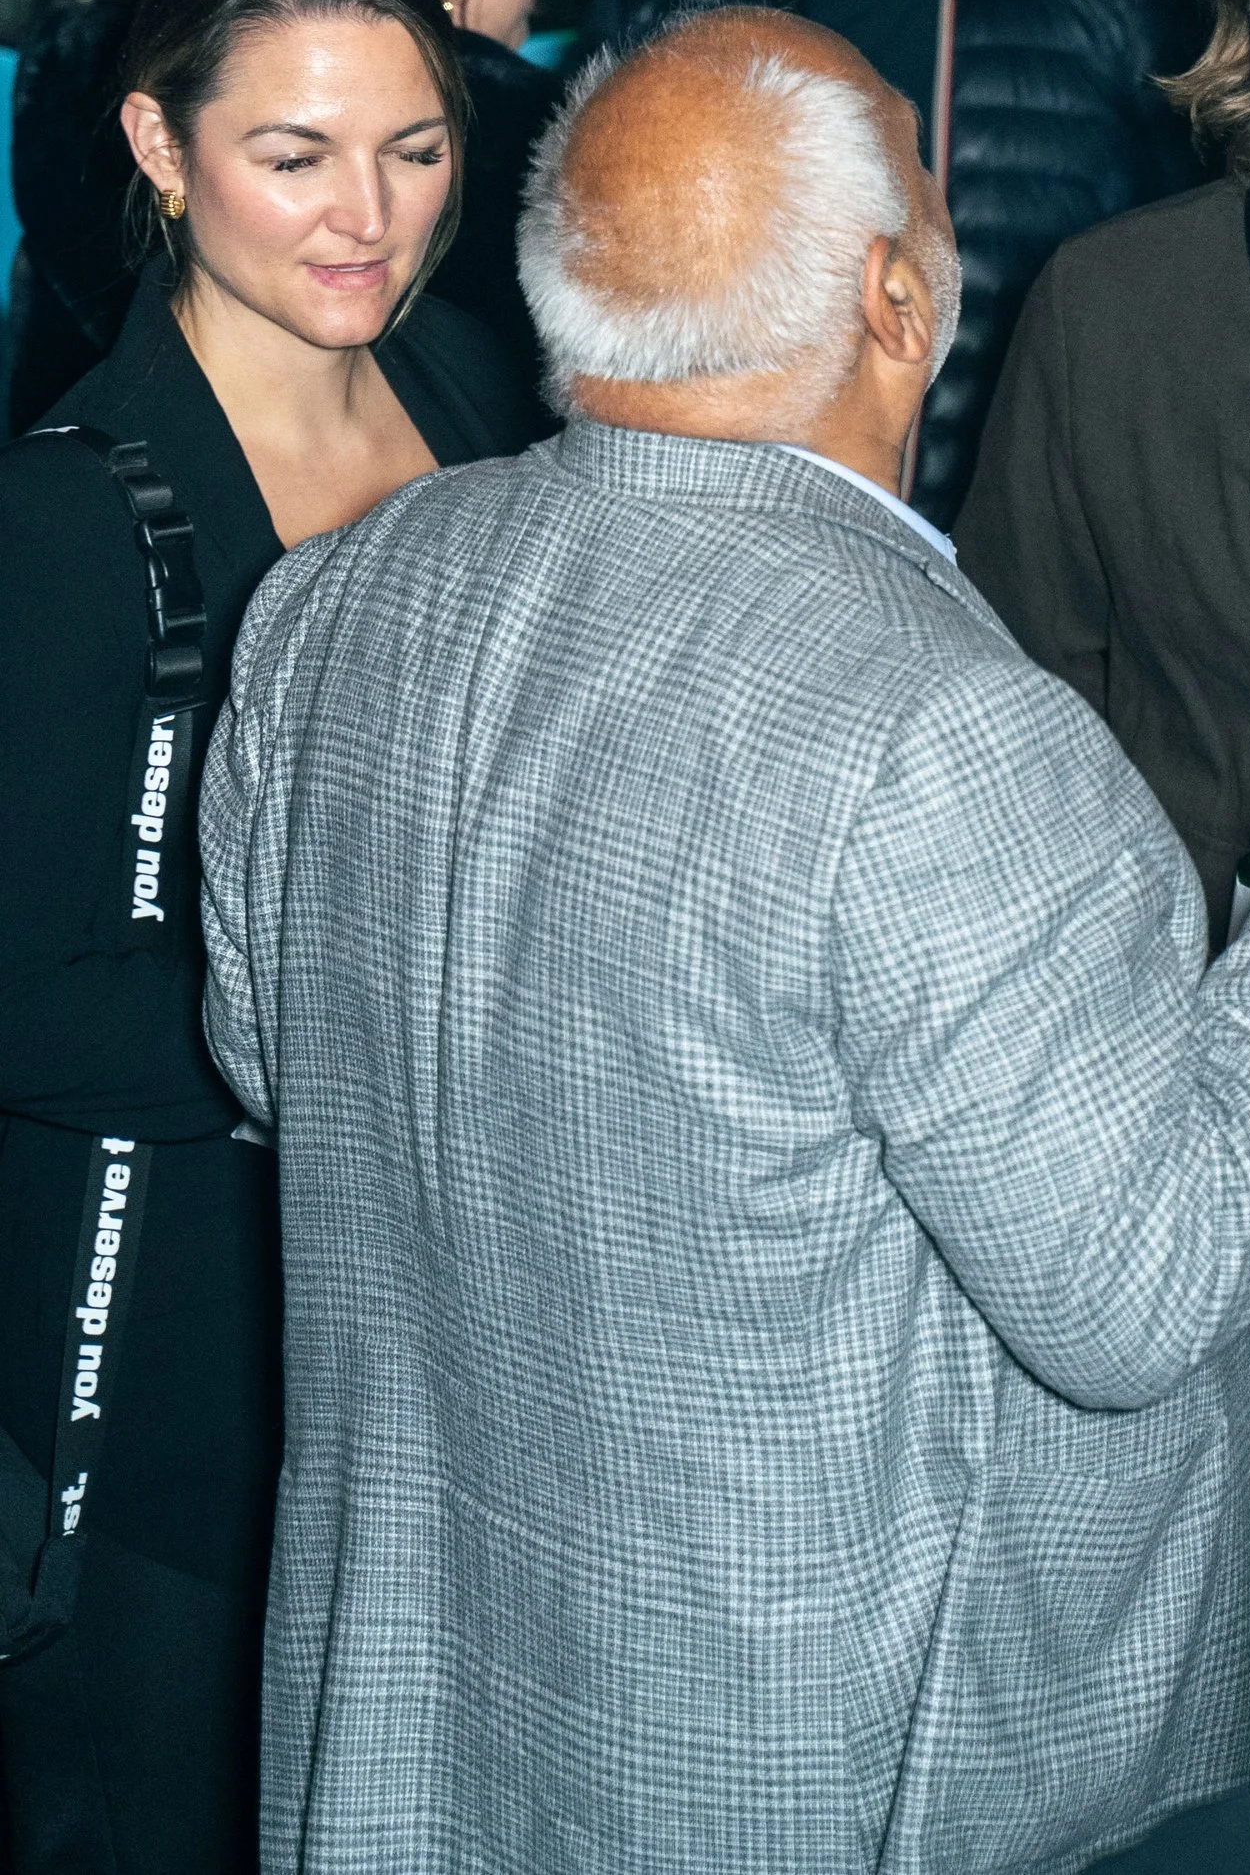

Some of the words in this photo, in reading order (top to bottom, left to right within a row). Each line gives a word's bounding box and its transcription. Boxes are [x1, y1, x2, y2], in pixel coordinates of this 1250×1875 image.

[131, 849, 165, 922] you
[75, 1163, 131, 1336] deserve
[70, 1344, 103, 1422] you
[62, 1472, 88, 1536] st.
